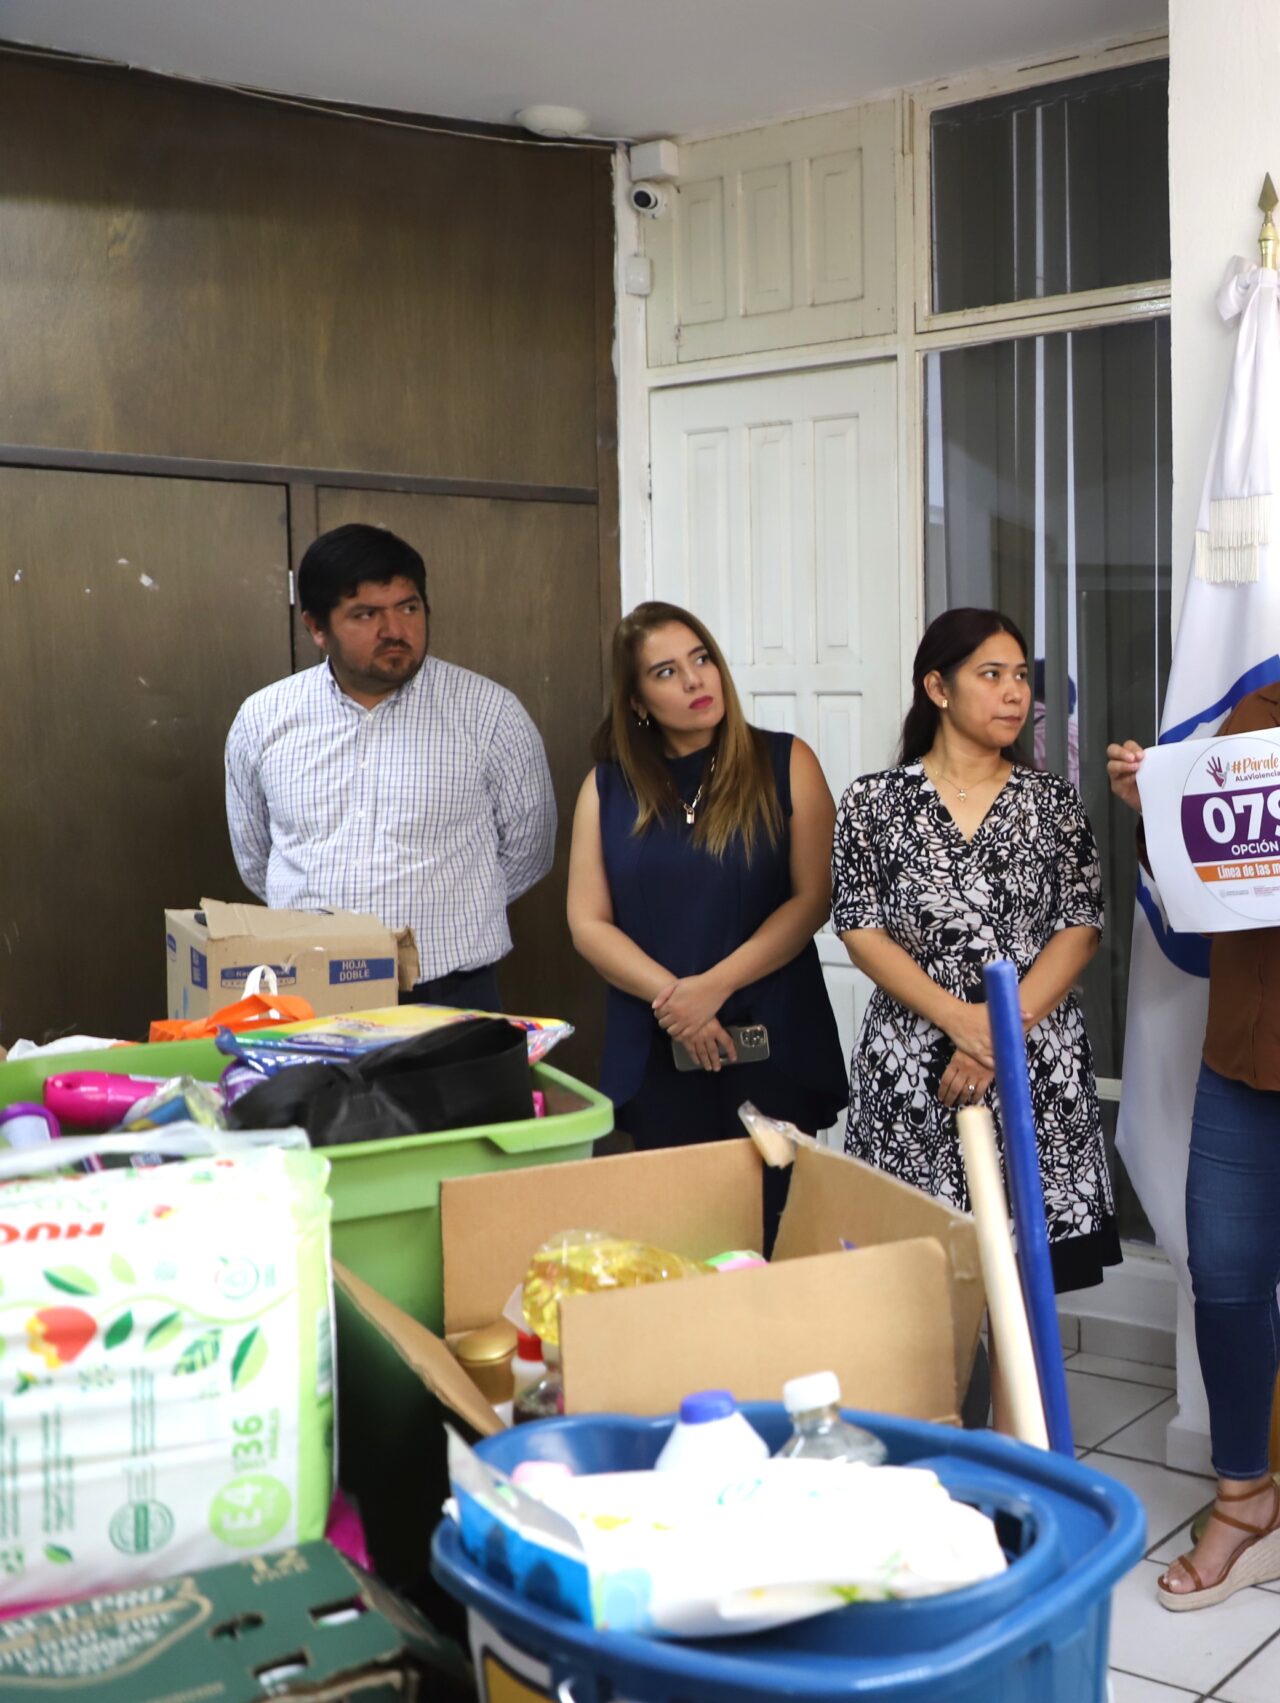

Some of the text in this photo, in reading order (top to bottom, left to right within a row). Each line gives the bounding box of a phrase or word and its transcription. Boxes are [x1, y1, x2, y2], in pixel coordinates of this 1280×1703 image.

[1231, 839, 1279, 856] OPCIÓN
[1217, 864, 1241, 879] Línea
[1242, 864, 1255, 877] de
[1255, 862, 1271, 876] las
[342, 960, 367, 970] HOJA
[339, 969, 370, 982] DOBLE
